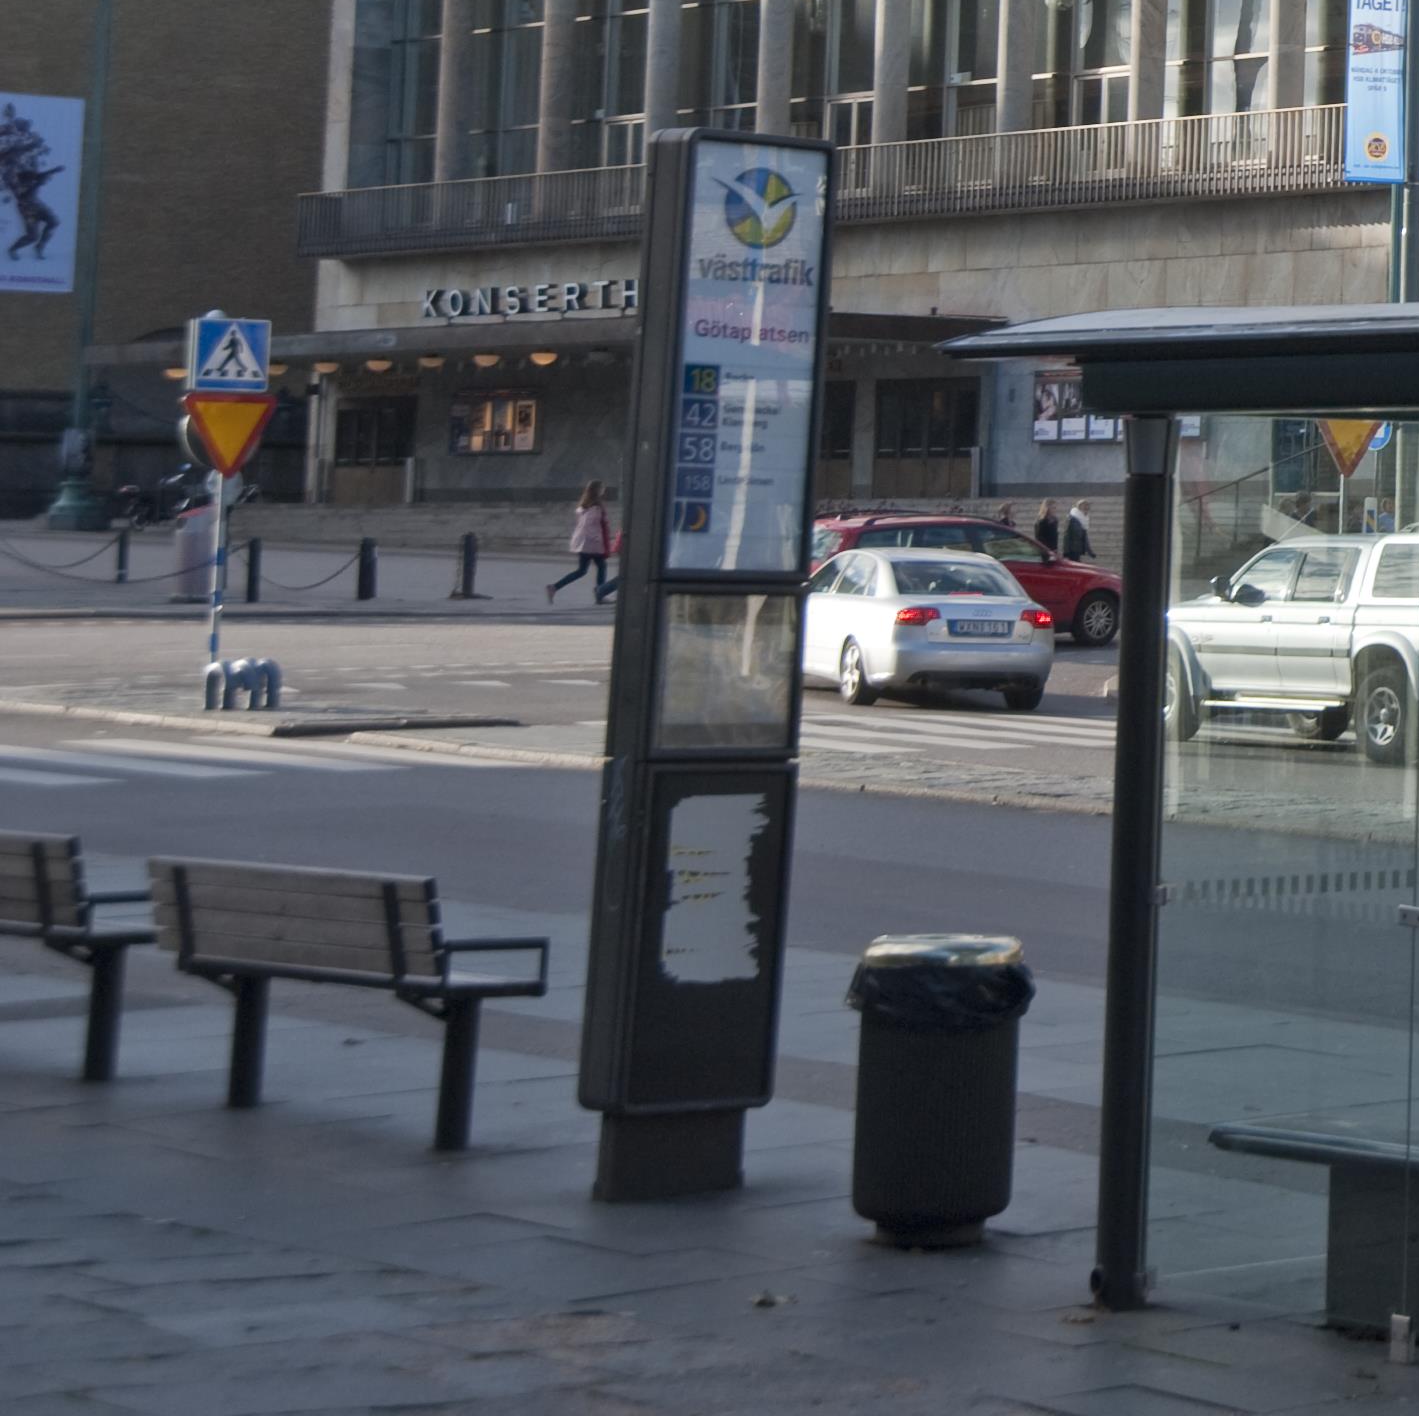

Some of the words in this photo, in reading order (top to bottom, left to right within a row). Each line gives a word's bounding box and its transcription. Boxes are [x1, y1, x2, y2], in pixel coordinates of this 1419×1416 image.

[698, 253, 815, 286] västtrafik
[422, 279, 639, 318] KONSERTH
[694, 319, 810, 344] Götapatsen
[691, 368, 717, 393] 18
[686, 403, 716, 427] 42
[684, 437, 714, 461] 58
[685, 475, 711, 491] 158
